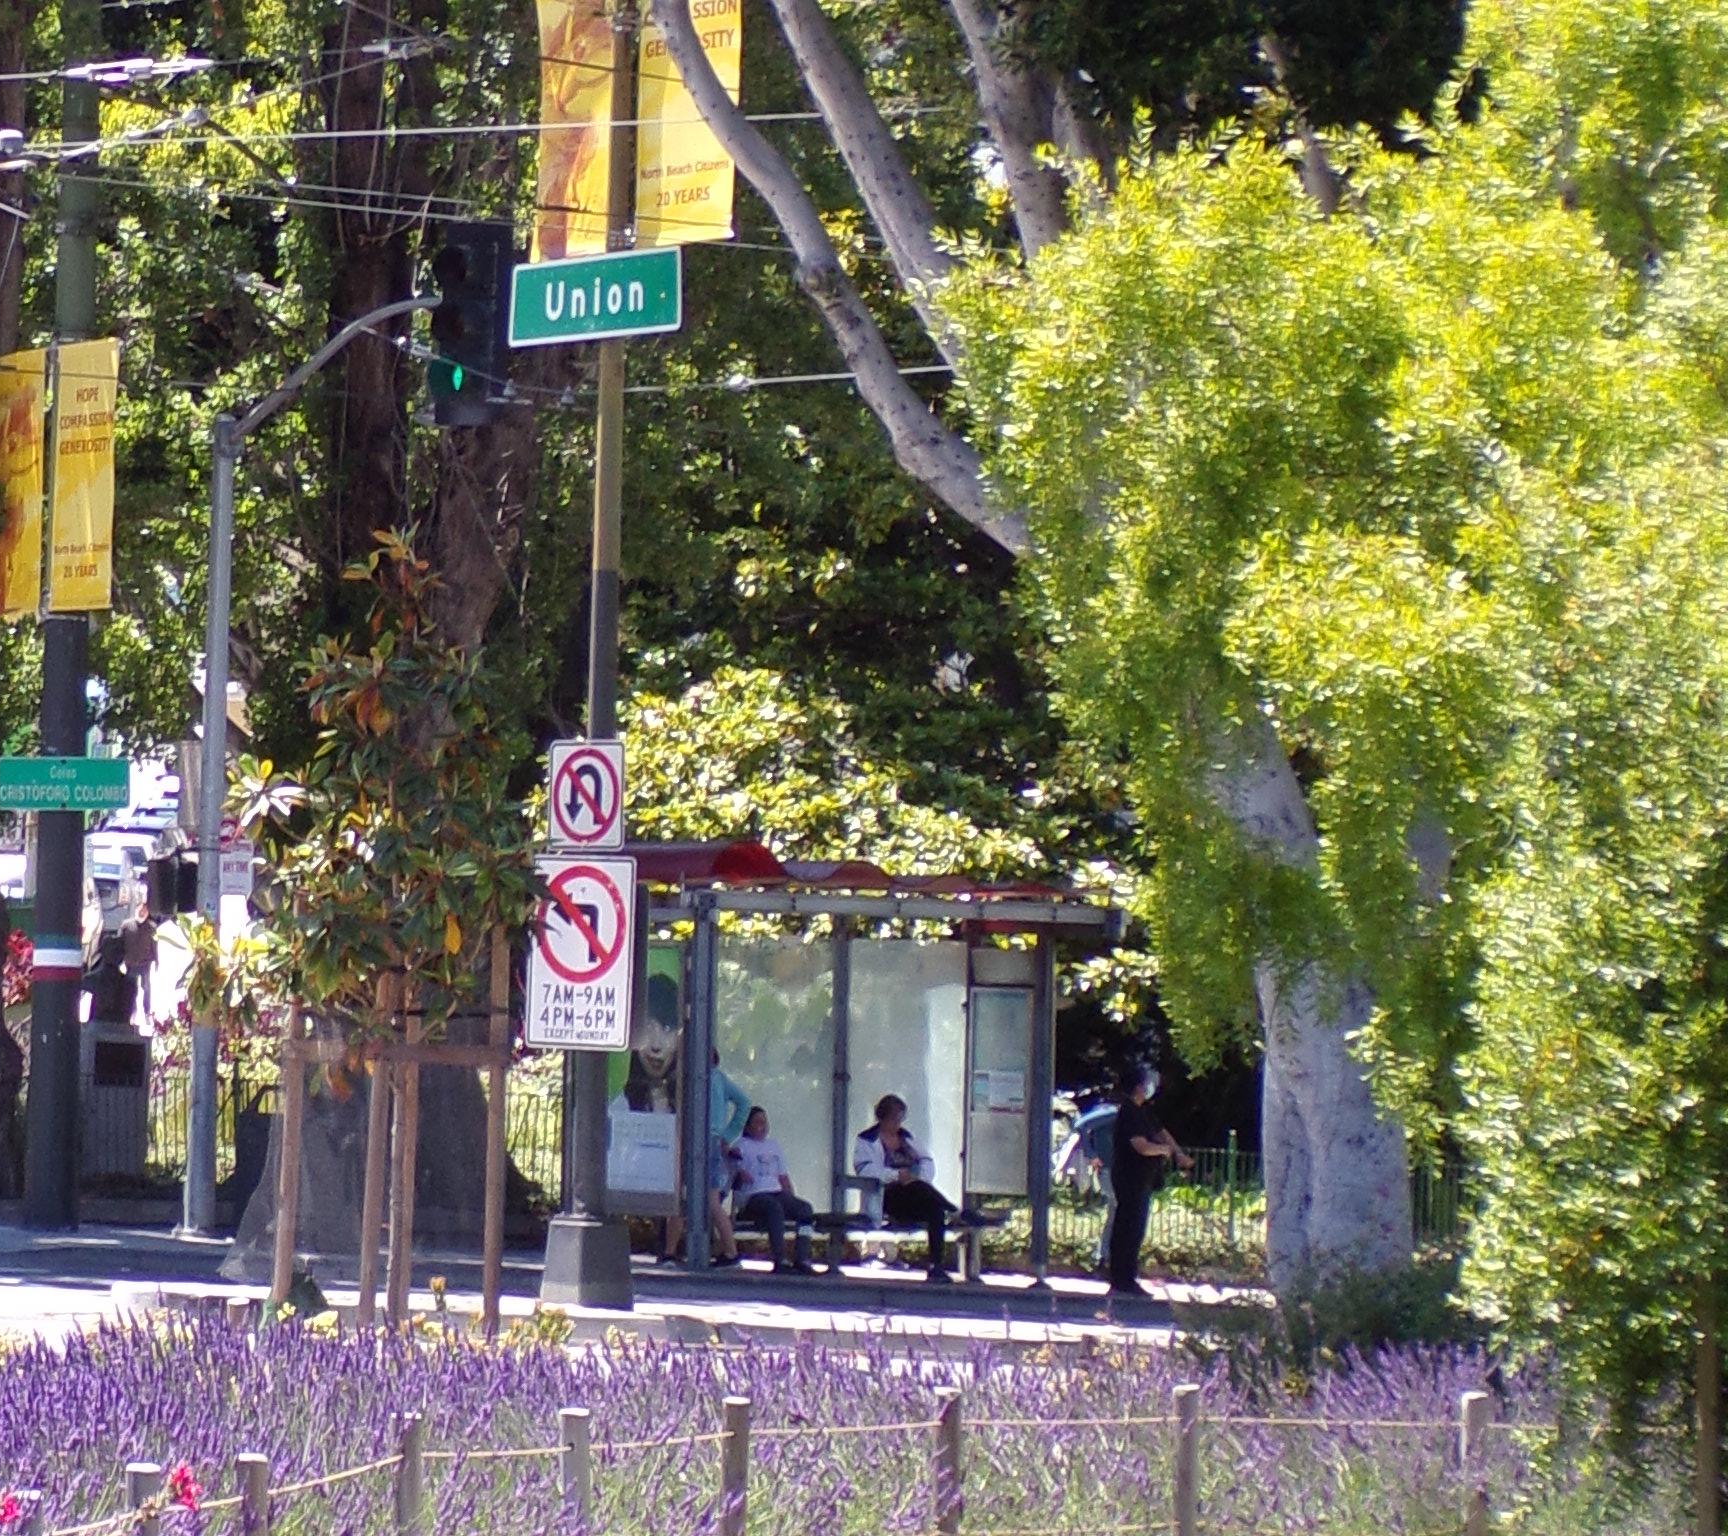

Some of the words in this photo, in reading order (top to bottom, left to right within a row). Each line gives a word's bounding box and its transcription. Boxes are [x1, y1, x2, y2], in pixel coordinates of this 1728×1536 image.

[645, 29, 734, 58] GESITY
[667, 162, 693, 177] Beach
[656, 191, 671, 207] 20
[674, 185, 711, 205] YEARS
[545, 276, 645, 322] Union
[76, 387, 100, 402] HOPE
[73, 785, 128, 802] COLOMBO
[542, 983, 616, 1006] 7AM-9AM
[540, 1006, 616, 1028] 4PM-6PM
[544, 1028, 574, 1039] EXCEPT
